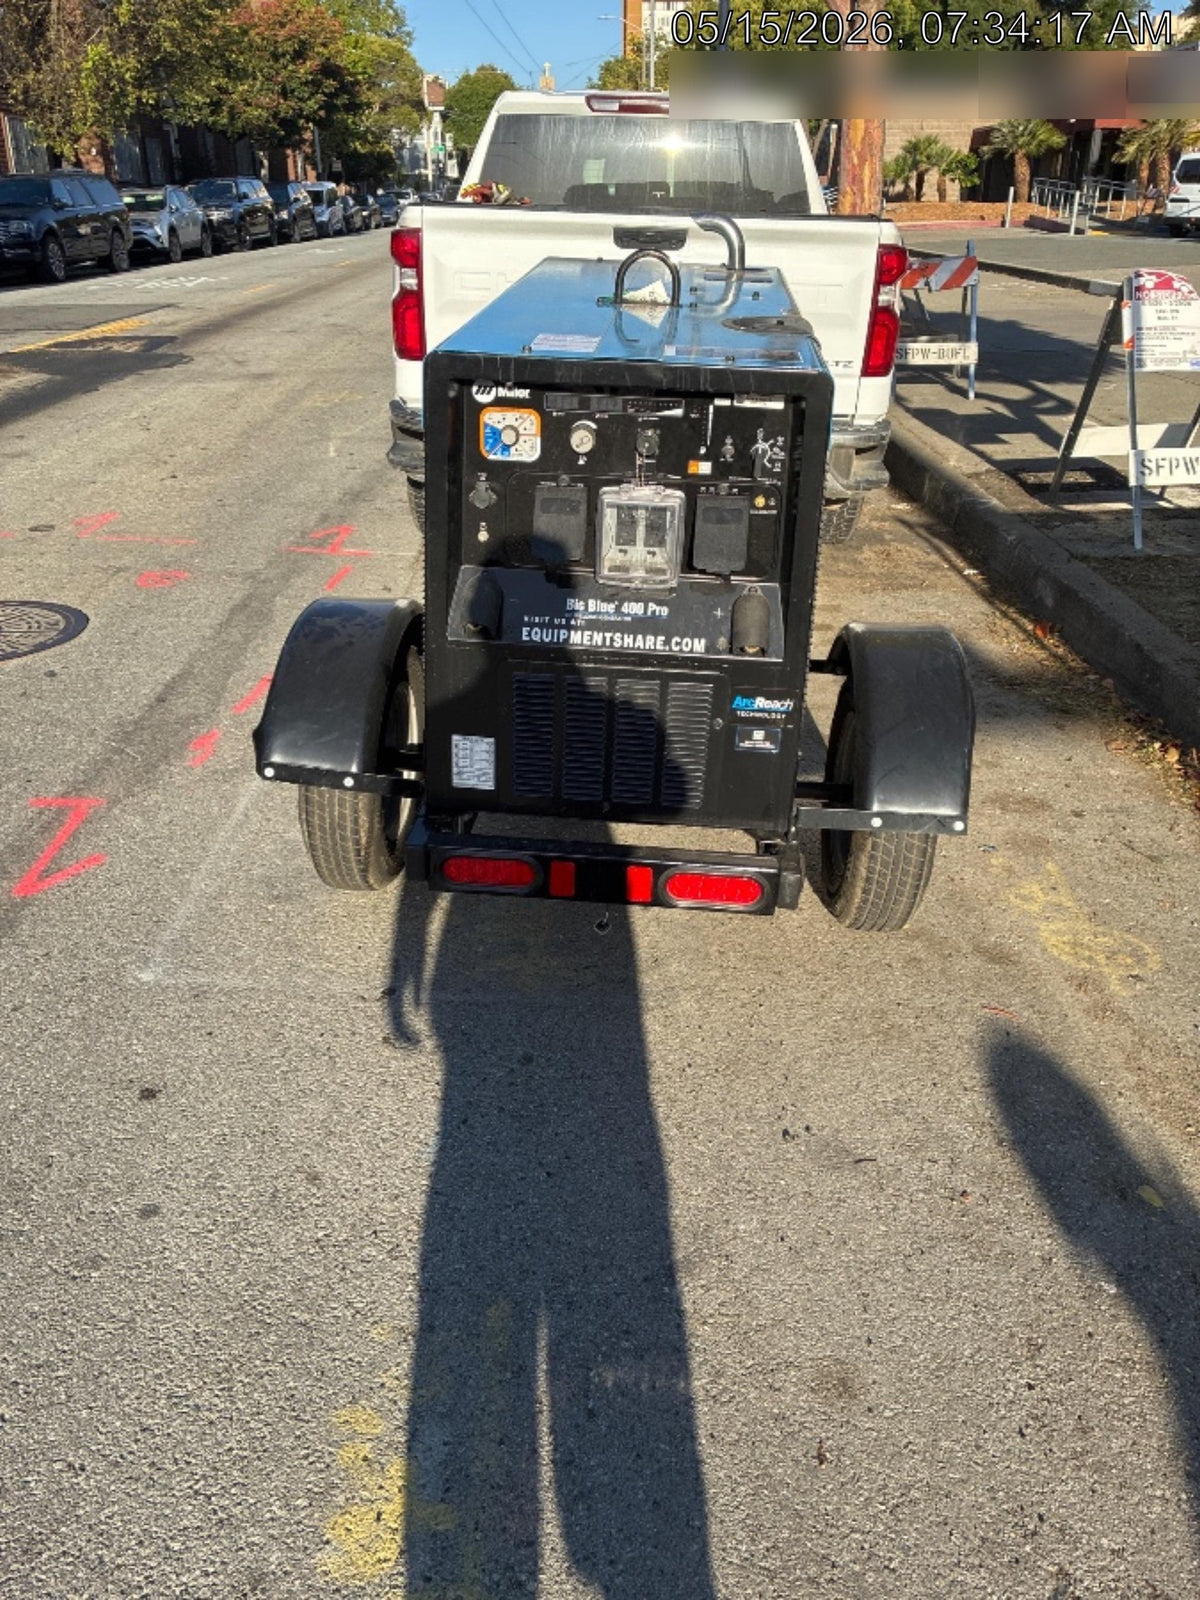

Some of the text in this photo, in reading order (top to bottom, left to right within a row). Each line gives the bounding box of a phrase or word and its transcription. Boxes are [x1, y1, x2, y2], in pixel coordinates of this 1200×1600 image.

[621, 601, 645, 615] 400
[647, 602, 669, 616] Pro
[521, 627, 706, 653] EQUIPMENTSHARE.COM
[732, 696, 793, 711] ArcReach
